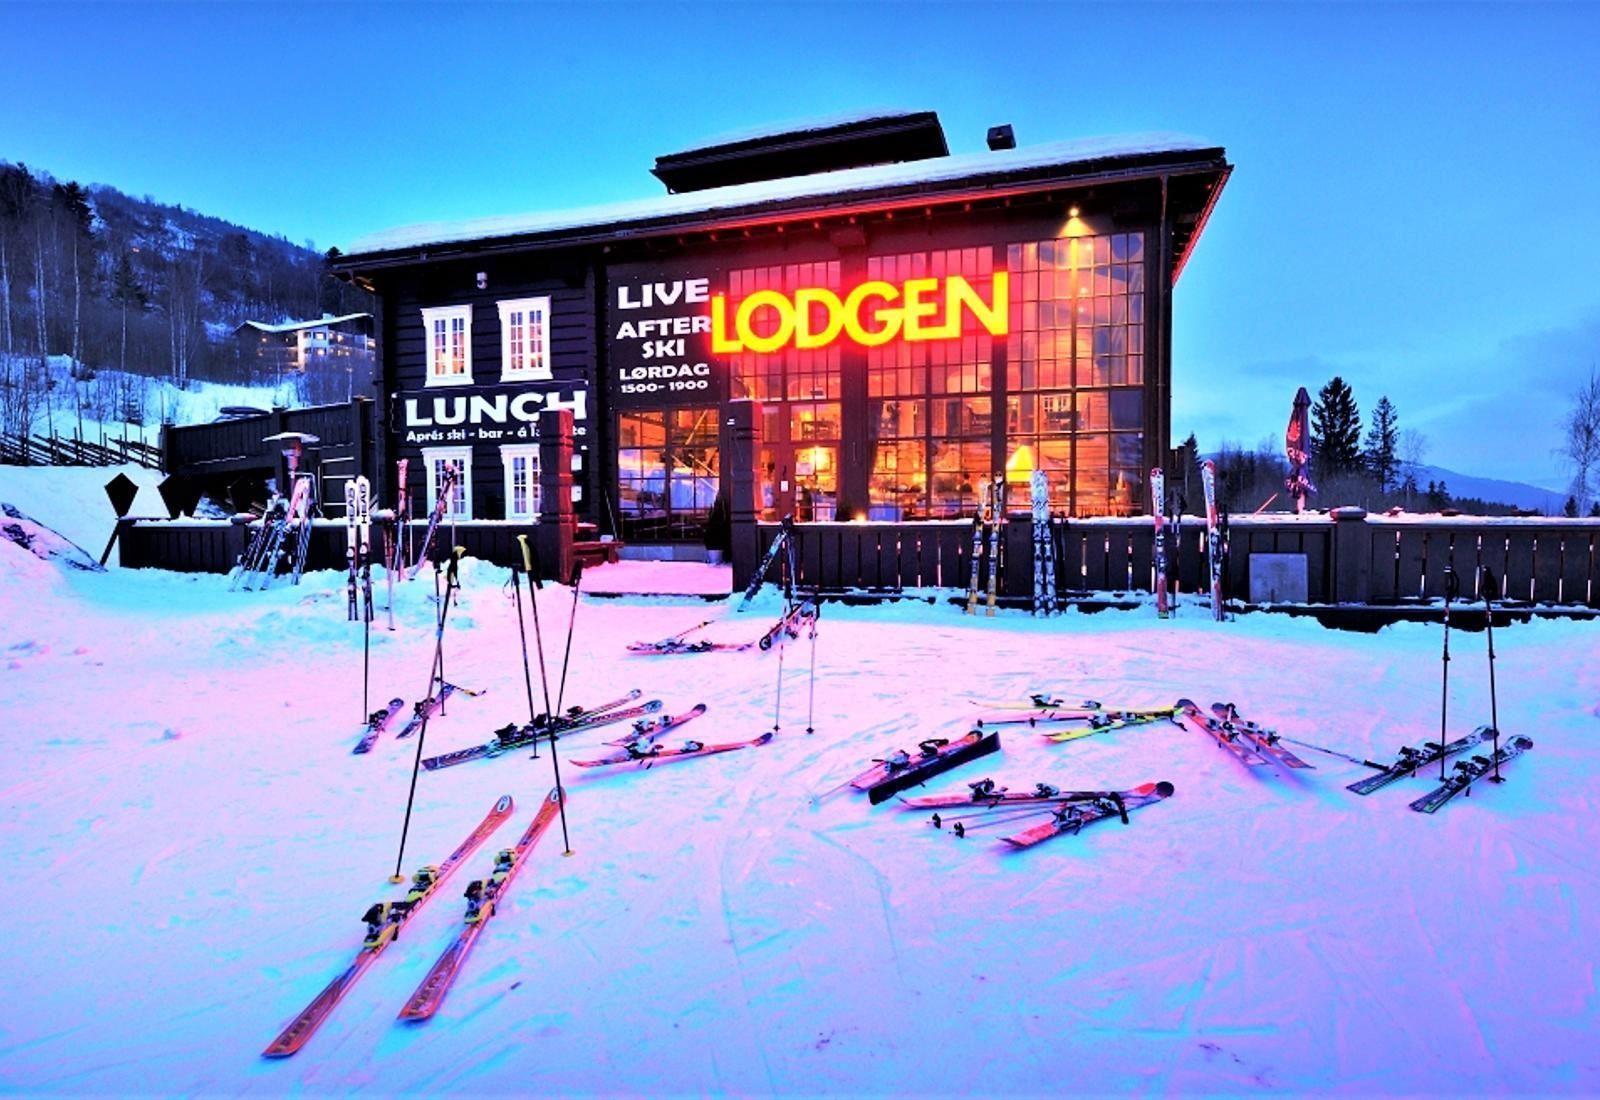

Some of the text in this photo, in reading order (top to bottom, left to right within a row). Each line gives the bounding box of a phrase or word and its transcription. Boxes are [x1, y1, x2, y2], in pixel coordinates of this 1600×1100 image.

[618, 278, 710, 309] LIVE
[711, 271, 1008, 353] LODGEN
[616, 315, 712, 340] AFTER
[641, 338, 685, 359] SKI
[619, 363, 710, 380] LØRDAG
[405, 390, 587, 426] LUNCH
[447, 428, 465, 440] ski
[478, 427, 504, 439] bar
